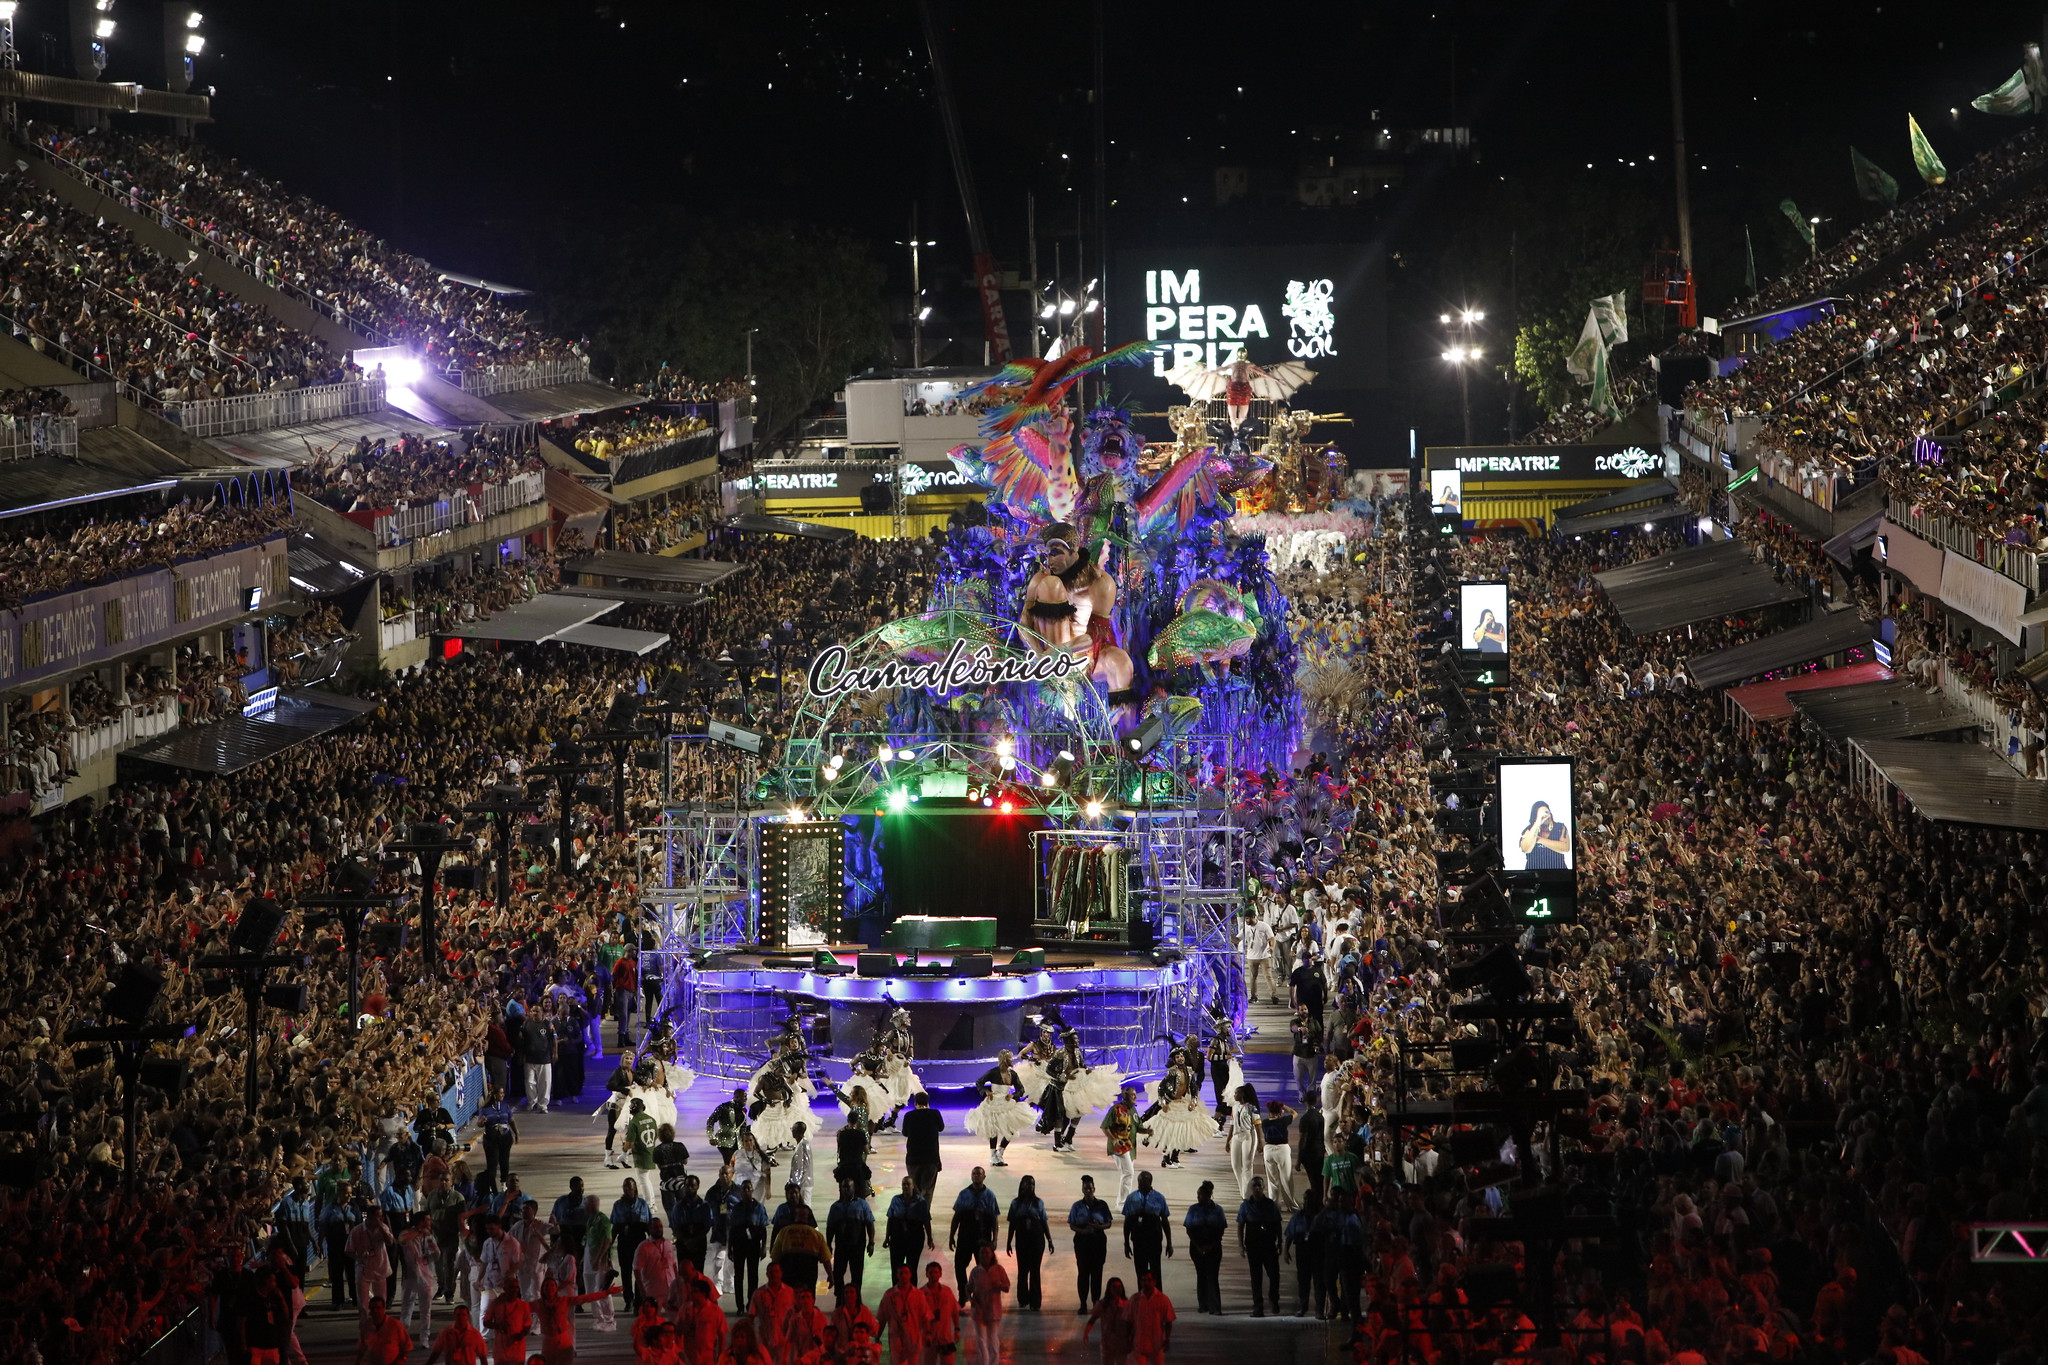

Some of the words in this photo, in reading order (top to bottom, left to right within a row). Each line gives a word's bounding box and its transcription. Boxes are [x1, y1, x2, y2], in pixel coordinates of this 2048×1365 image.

[1146, 269, 1200, 305] IM
[1146, 304, 1269, 341] PERA
[1455, 455, 1561, 473] IMPERATRIZ
[200, 564, 241, 618] ENCONTROS
[808, 638, 1090, 698] Camaleônico
